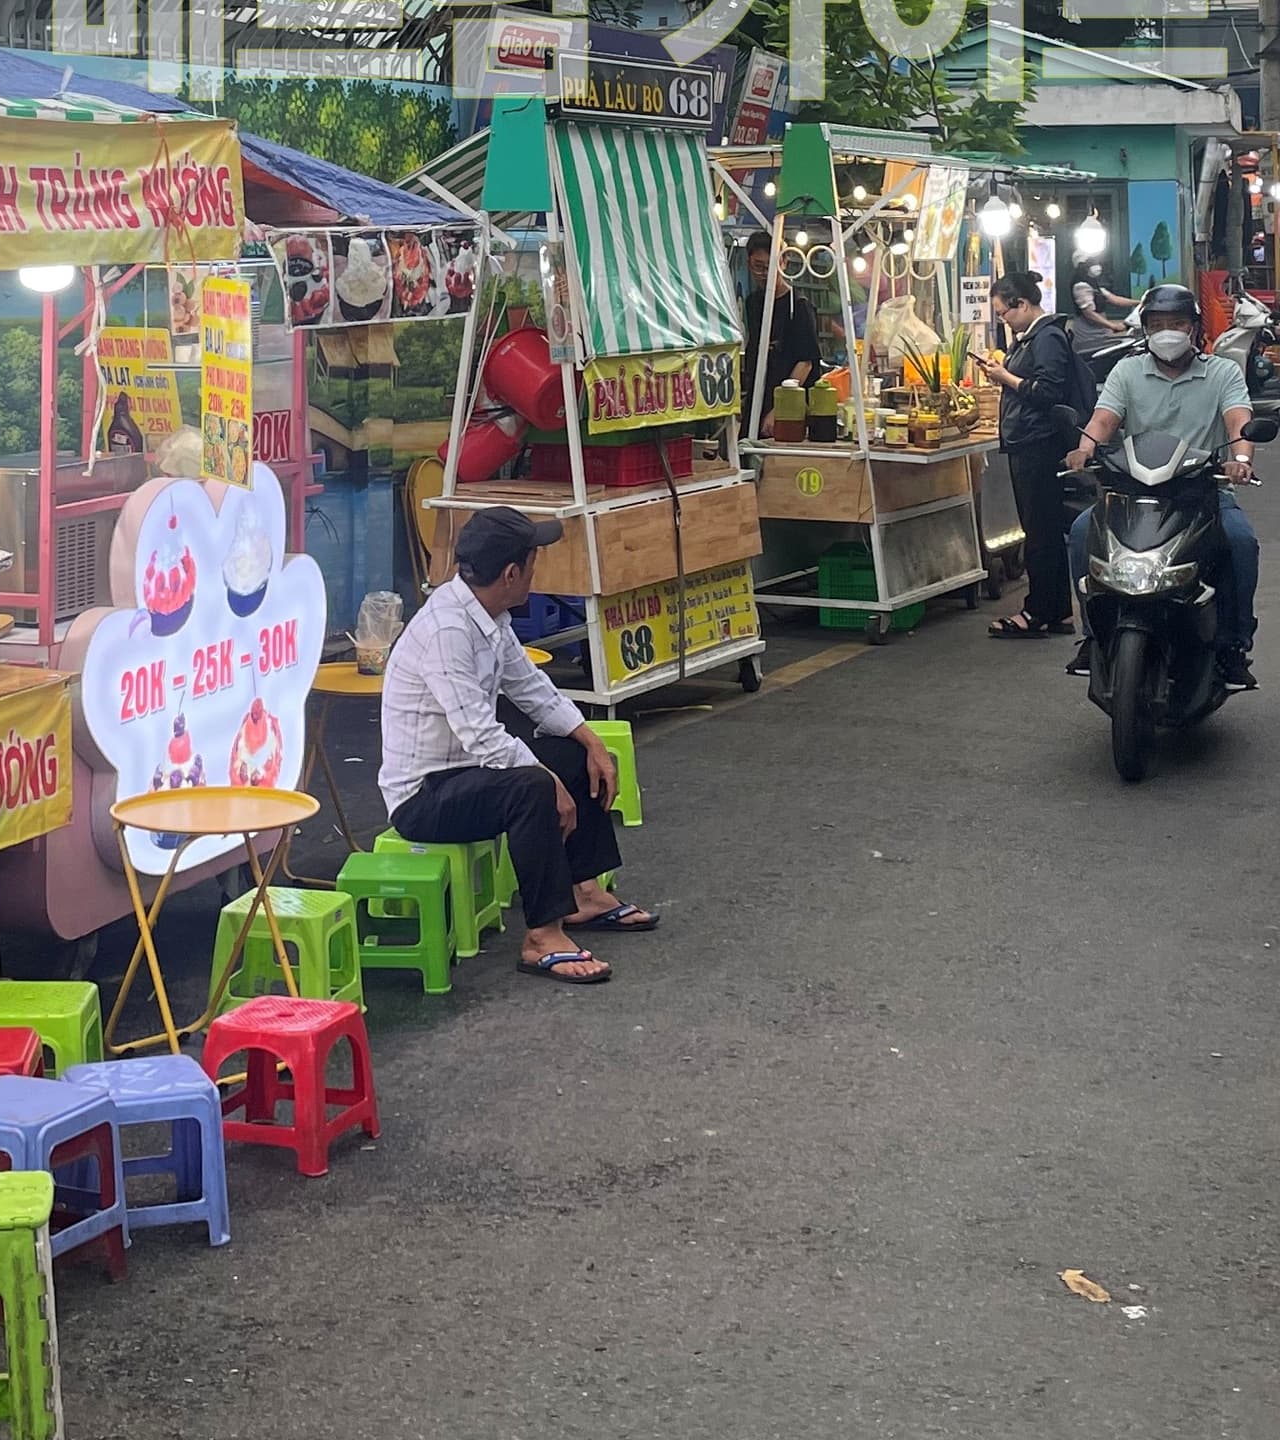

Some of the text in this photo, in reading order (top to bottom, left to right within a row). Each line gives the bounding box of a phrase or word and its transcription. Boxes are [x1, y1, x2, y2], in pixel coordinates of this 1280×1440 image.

[669, 76, 709, 117] 68
[29, 152, 141, 231] TRÁNG
[697, 352, 736, 409] 68
[798, 470, 820, 492] 19
[120, 659, 166, 723] 20K
[192, 638, 234, 698] 25K
[258, 618, 298, 676] 30K
[620, 624, 656, 672] 68
